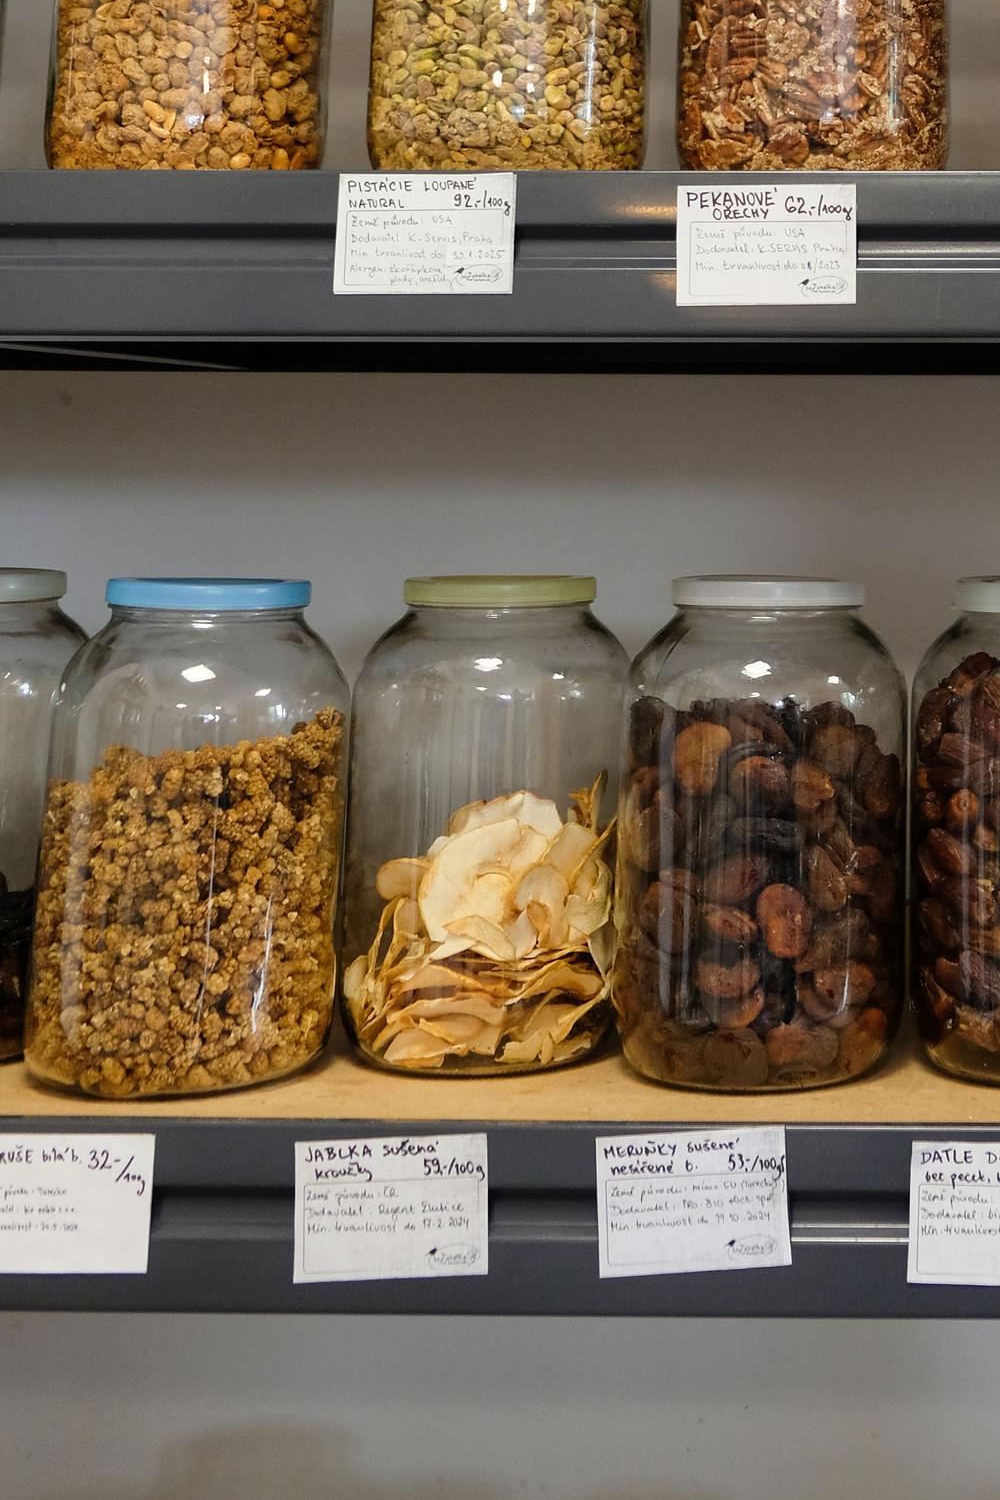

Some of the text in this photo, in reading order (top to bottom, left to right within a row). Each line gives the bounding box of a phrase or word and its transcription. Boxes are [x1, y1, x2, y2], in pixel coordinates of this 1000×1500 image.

[347, 176, 478, 194] PISTÁCIE LOUPANÉ
[348, 198, 405, 209] NATURAL
[686, 187, 778, 209] PEKANOVÉ
[712, 203, 769, 221] OŘECHY
[784, 227, 806, 238] USA
[722, 259, 781, 272] trvanlivost
[304, 1139, 440, 1164] JABLKA sušená
[603, 1136, 740, 1161] MERUŇKY sušené
[919, 1148, 974, 1166] DATLE
[314, 1159, 373, 1183] kroužky
[610, 1158, 674, 1177] nesířené
